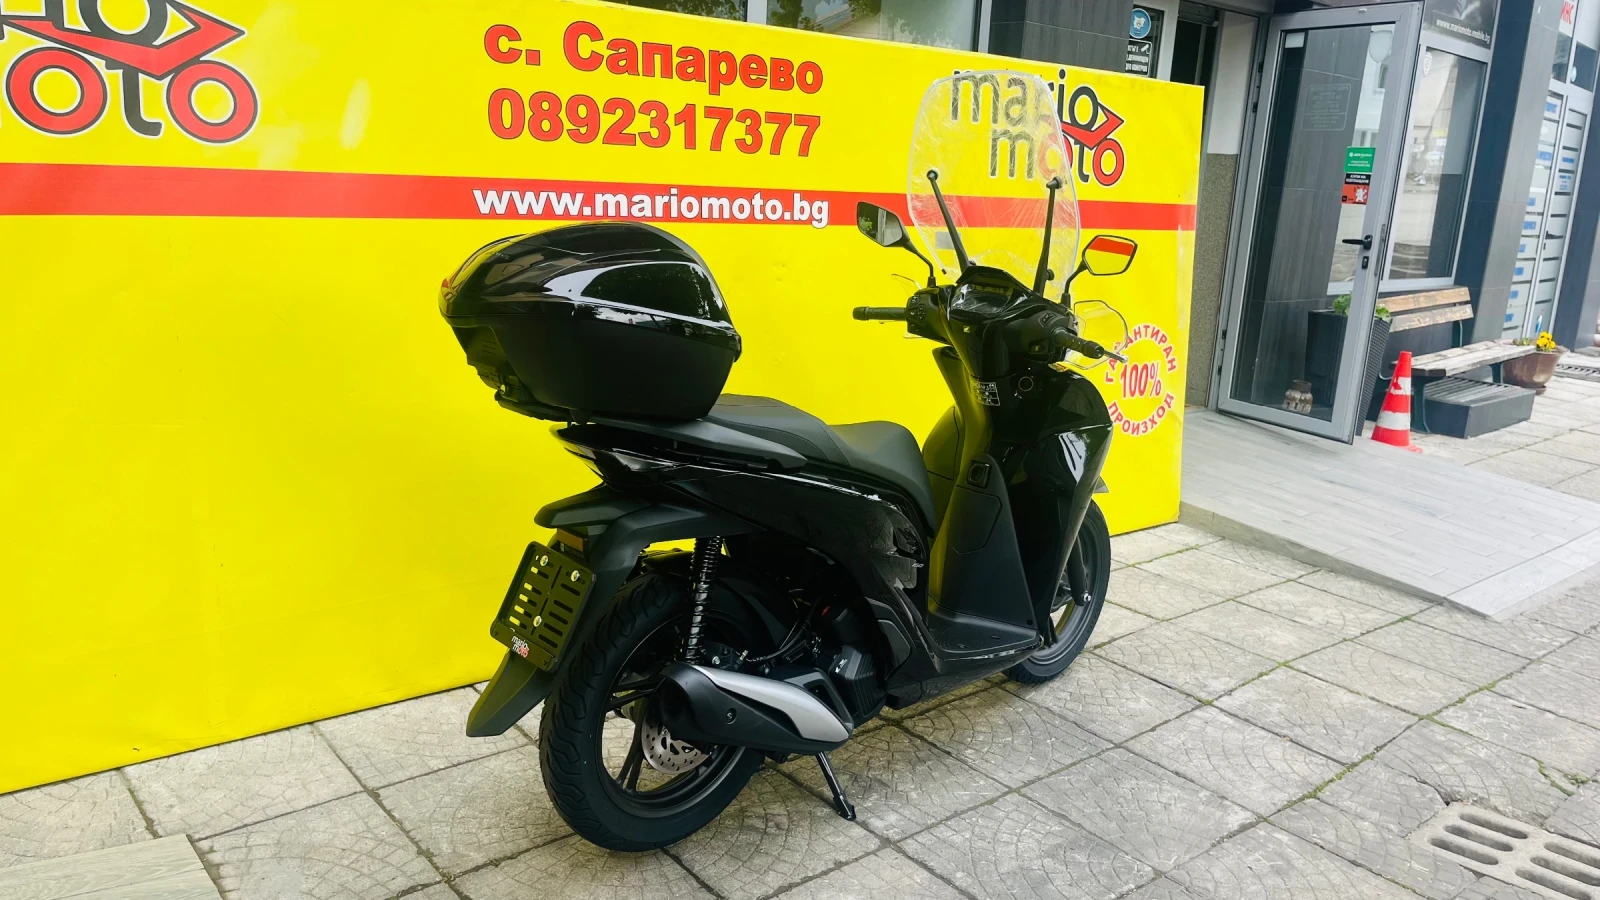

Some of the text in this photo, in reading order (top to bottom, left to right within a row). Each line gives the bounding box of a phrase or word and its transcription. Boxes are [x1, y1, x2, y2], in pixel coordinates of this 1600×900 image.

[484, 20, 824, 96] с. Сапарево
[487, 88, 821, 157] 0892317377
[950, 68, 1100, 132] mario
[989, 127, 1124, 187] moto
[473, 187, 829, 228] www.mariomoto.bg
[1120, 363, 1162, 398] 100%
[1108, 393, 1174, 435] ПРОИЗХОД
